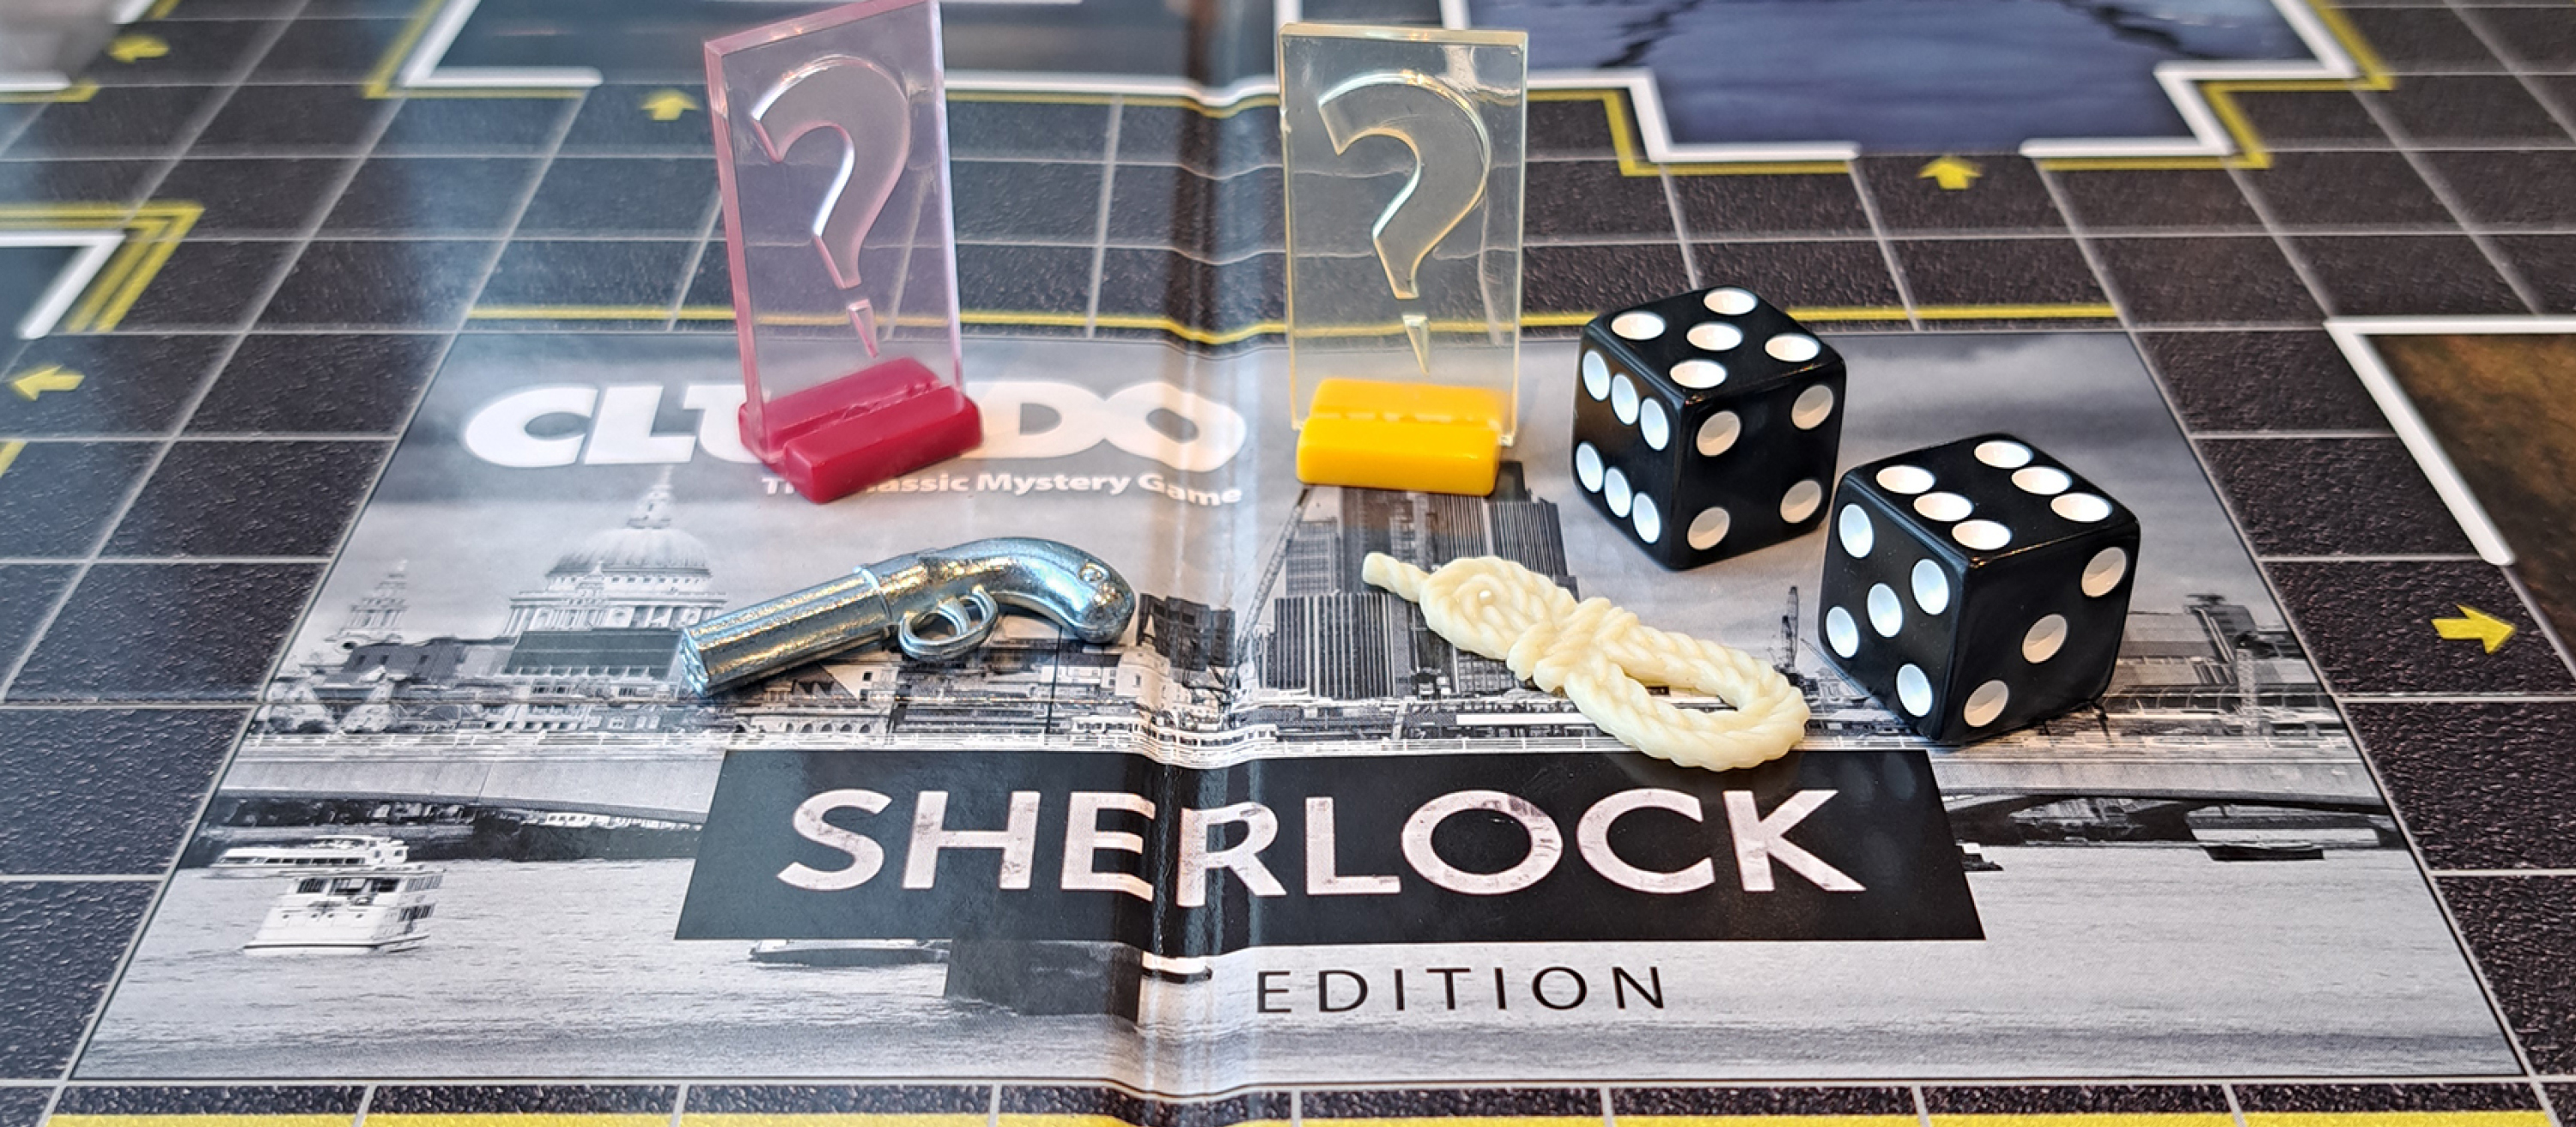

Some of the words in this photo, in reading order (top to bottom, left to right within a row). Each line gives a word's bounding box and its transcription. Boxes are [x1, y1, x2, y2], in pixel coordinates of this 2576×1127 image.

[976, 473, 1132, 495] Mystery
[1138, 474, 1242, 506] Game
[776, 788, 1866, 907] SHERLOCK
[1256, 965, 1667, 1013] EDITION
